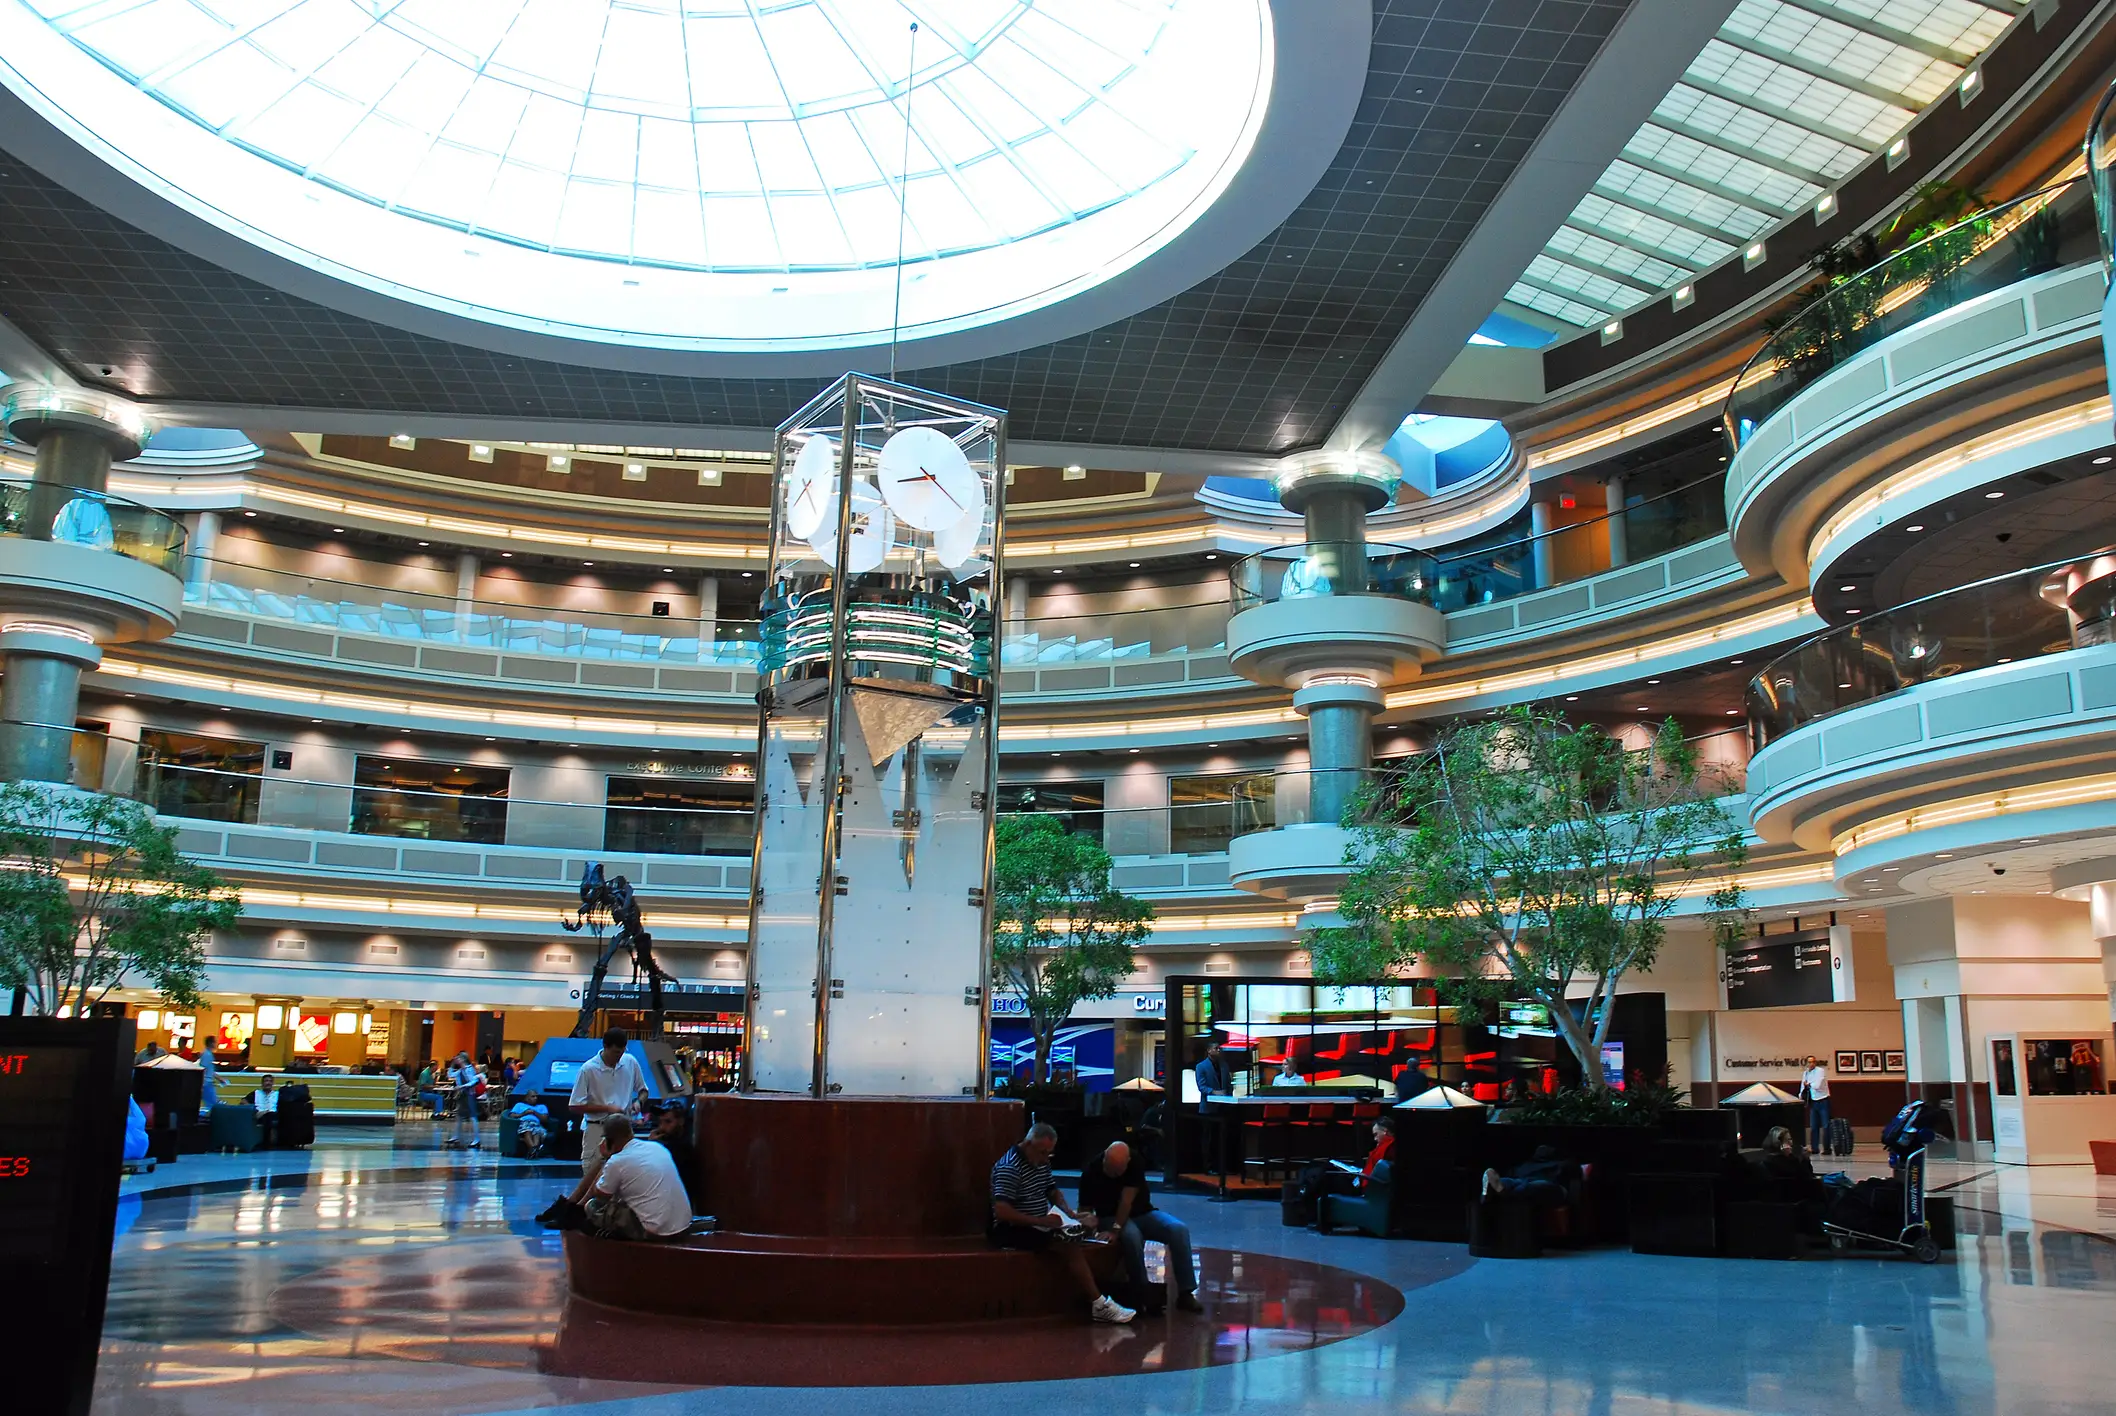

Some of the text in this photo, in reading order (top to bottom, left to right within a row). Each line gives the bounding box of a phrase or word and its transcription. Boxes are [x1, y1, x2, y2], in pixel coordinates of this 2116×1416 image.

[619, 983, 736, 995] TEMINAL
[1726, 1059, 1758, 1068] Customer
[1759, 1058, 1783, 1067] Service
[1784, 1058, 1799, 1067] Wall
[0, 1157, 30, 1176] ES
